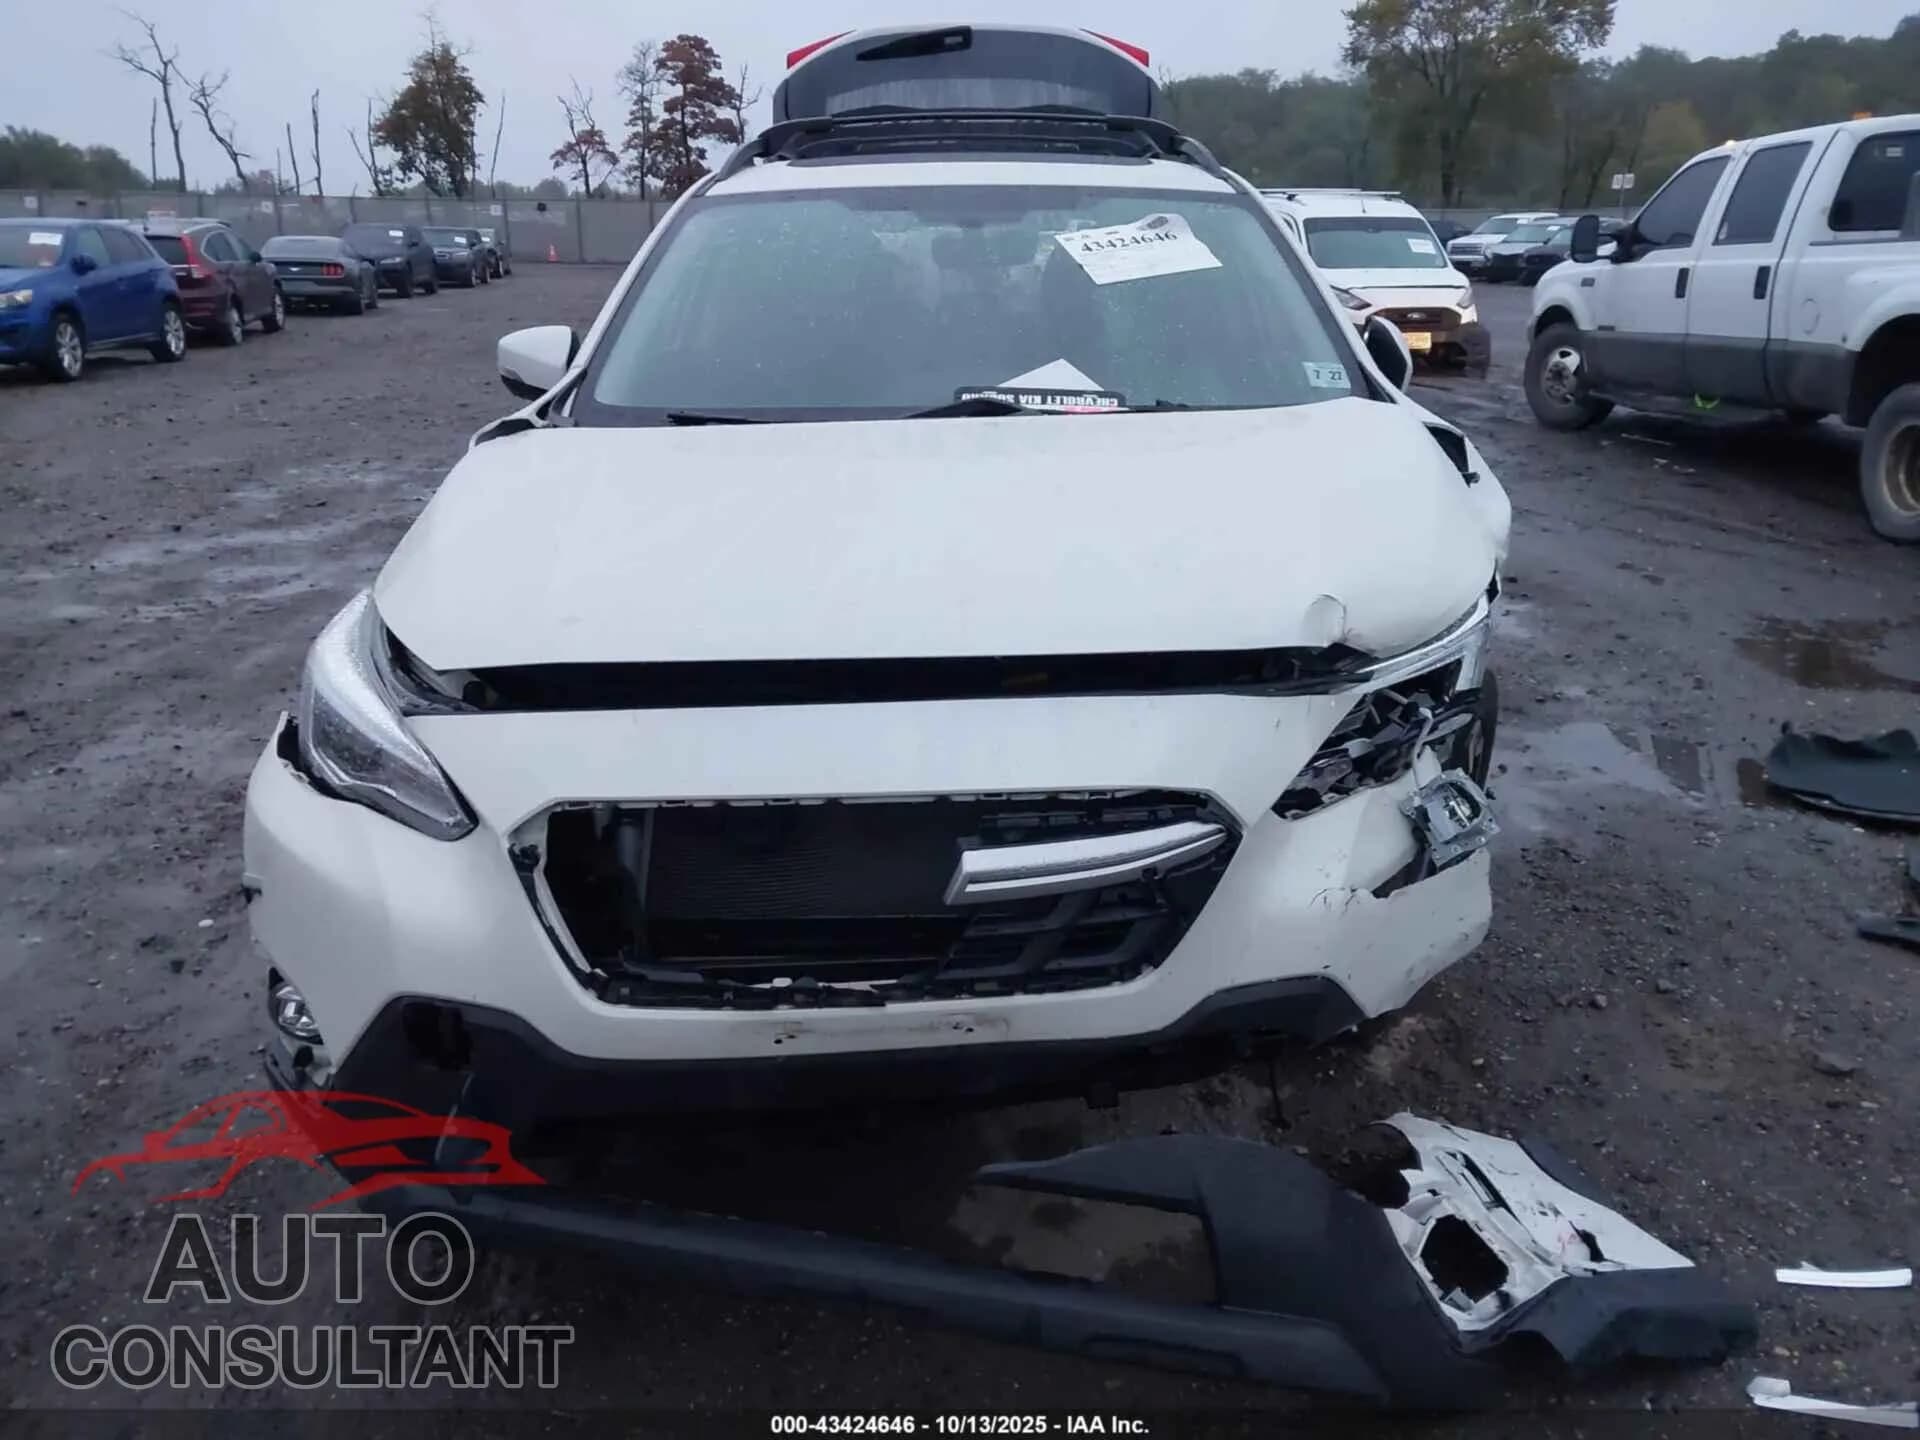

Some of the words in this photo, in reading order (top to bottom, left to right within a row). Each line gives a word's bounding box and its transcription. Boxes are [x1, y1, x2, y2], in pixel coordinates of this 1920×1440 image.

[1081, 230, 1178, 252] 43424646
[1019, 393, 1042, 405] KIA
[1047, 394, 1119, 407] CHEVROLET
